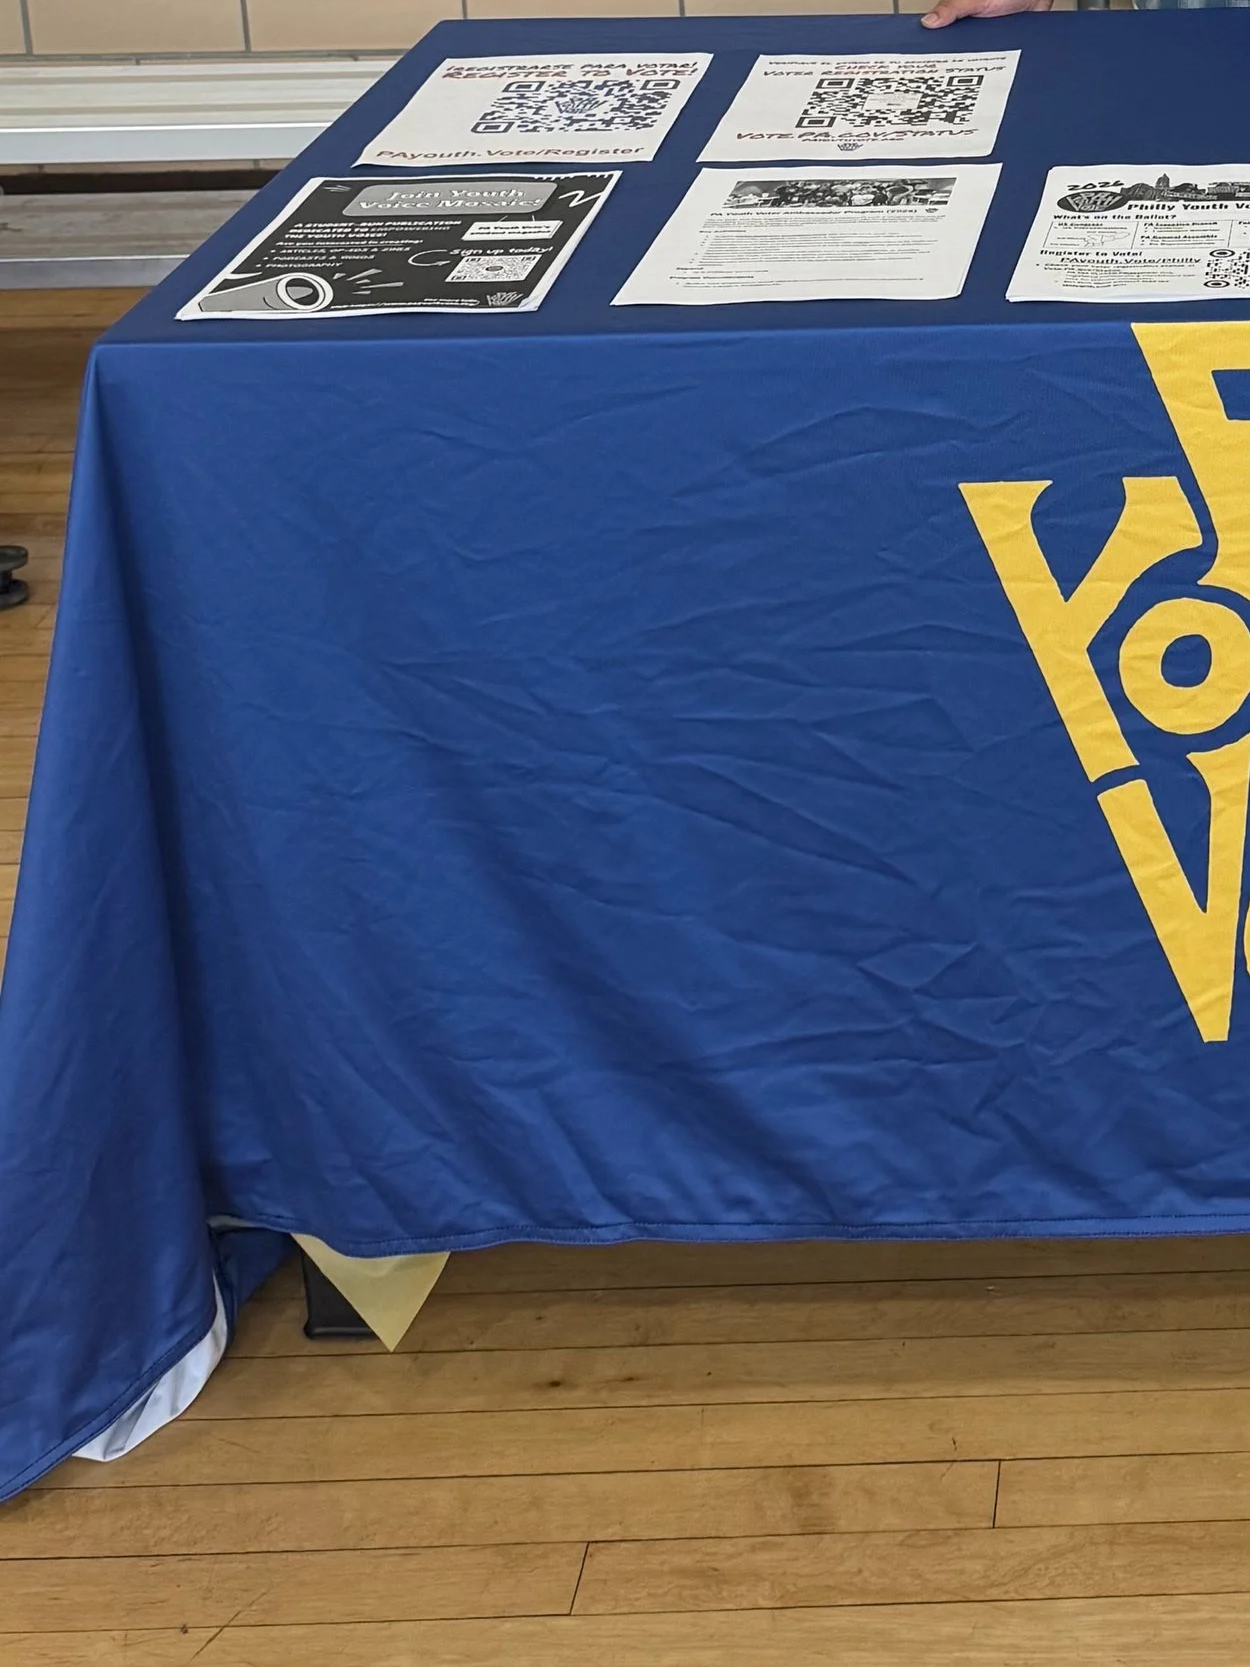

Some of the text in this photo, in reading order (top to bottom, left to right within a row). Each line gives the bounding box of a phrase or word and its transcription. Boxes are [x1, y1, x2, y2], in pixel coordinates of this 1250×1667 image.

[442, 69, 568, 79] REGISTER
[626, 68, 698, 77] VOTE!
[1067, 180, 1124, 191] 2026
[386, 189, 525, 201] Join Youth
[359, 199, 542, 209] Voice Mosaic!
[1127, 203, 1175, 211] Philly
[509, 246, 554, 254] today!
